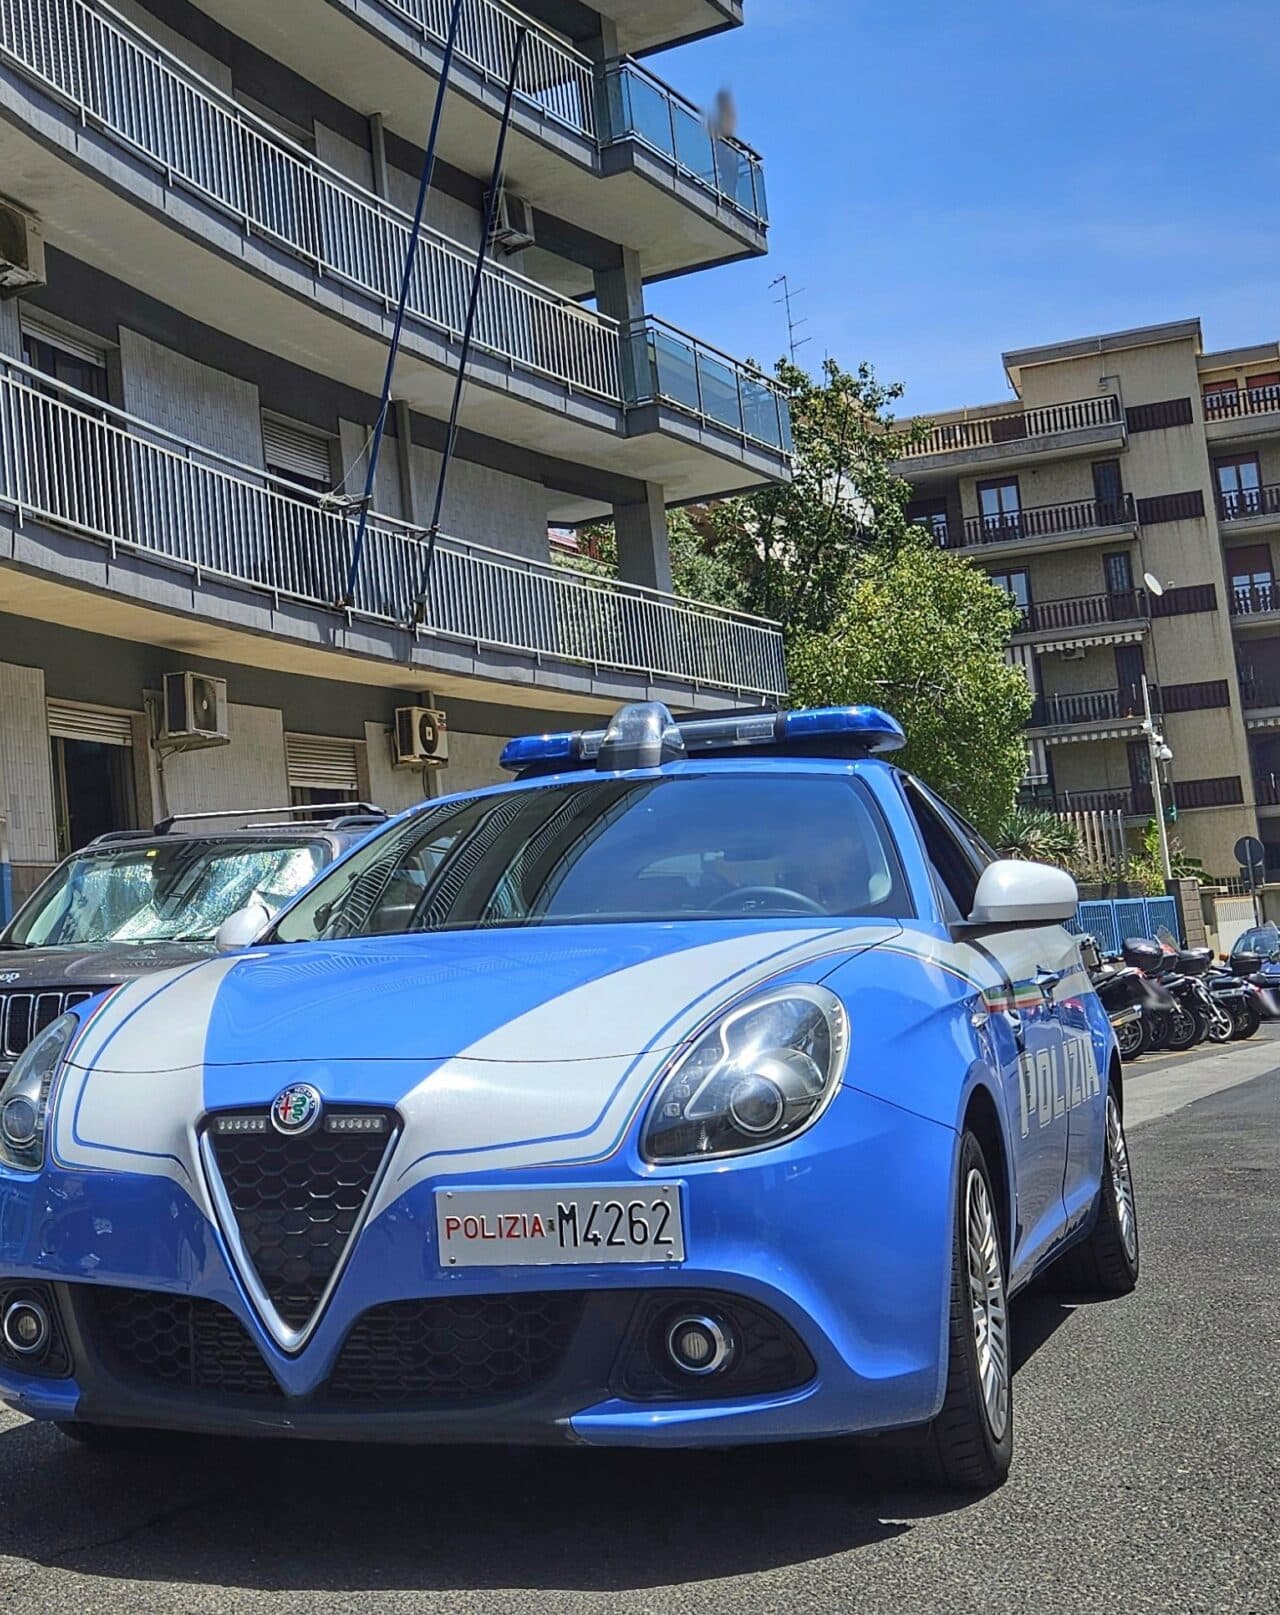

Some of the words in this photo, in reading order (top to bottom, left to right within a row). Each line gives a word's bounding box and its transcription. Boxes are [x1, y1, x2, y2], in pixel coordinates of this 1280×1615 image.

[1019, 1036, 1101, 1139] POLIZIA
[445, 1214, 546, 1240] POLIZIA
[556, 1199, 674, 1248] M4262
